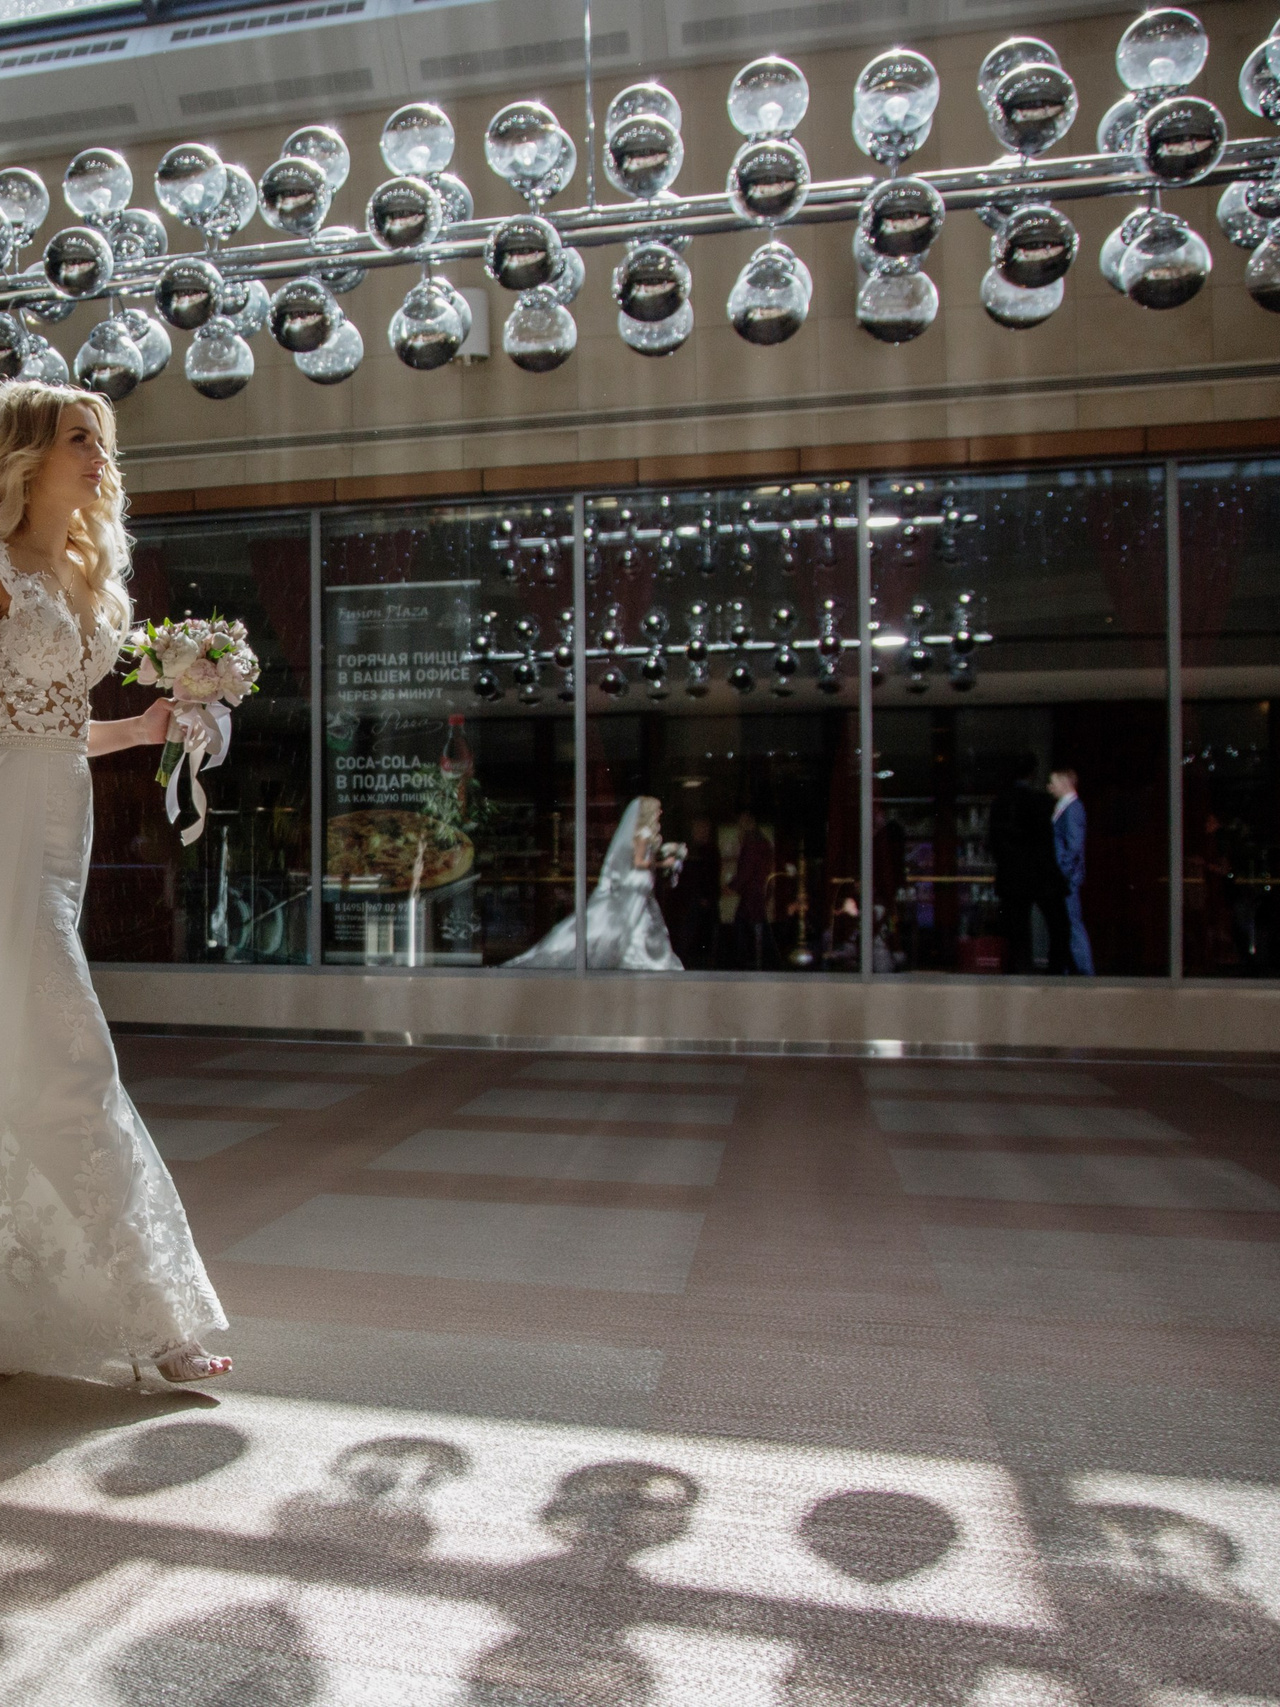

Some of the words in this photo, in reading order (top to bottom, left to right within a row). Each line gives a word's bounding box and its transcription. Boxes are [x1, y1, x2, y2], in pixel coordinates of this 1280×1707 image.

[338, 652, 408, 667] ГОРЯЧАЯ
[338, 671, 347, 685] В
[354, 669, 410, 684] ВАШЕМ
[416, 666, 470, 682] ОФИСЕ
[338, 689, 377, 701] ЧЕРЕЗ
[381, 688, 395, 701] 25
[398, 687, 443, 700] МИНУТ
[336, 755, 421, 769] COCA-COLA
[336, 776, 347, 789] В
[353, 773, 435, 791] ПОДАРОК
[337, 794, 350, 804] ЗА
[352, 793, 399, 805] КАЖДУЮ
